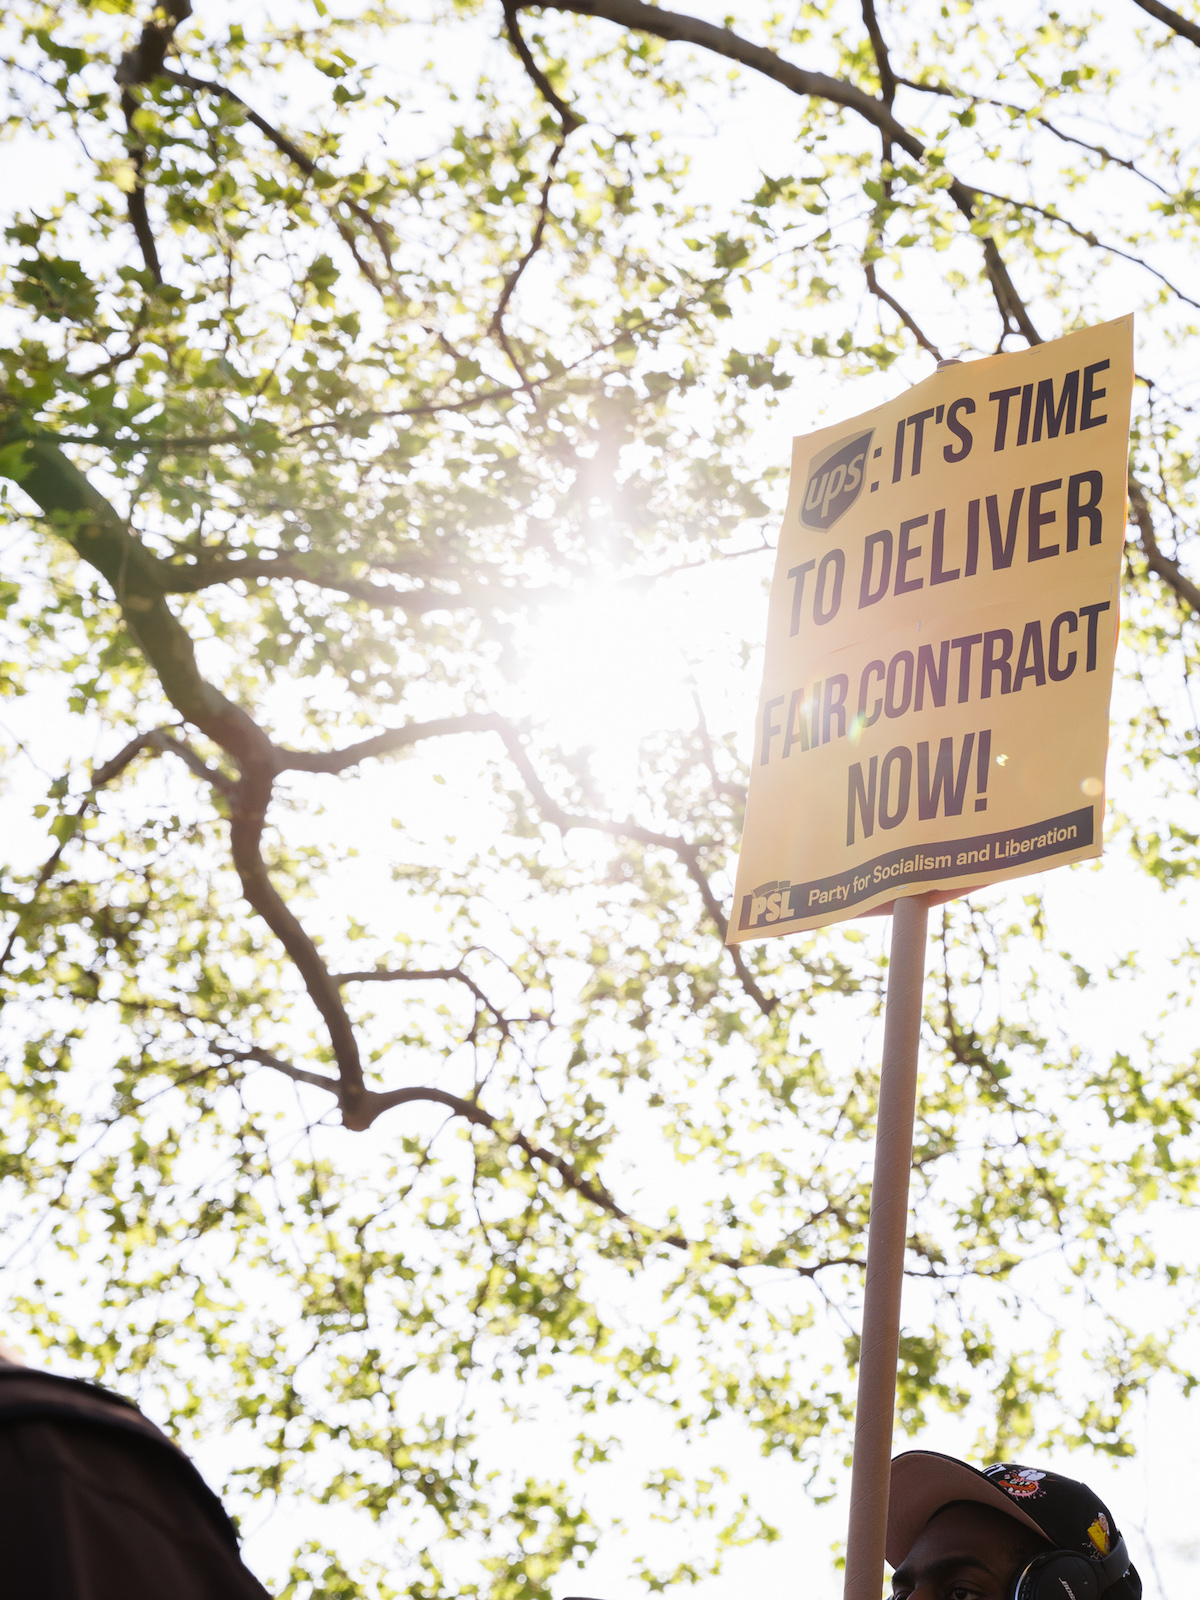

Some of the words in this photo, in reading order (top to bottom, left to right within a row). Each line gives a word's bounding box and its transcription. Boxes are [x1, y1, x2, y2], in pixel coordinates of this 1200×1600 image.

[892, 397, 976, 484] IT'S
[989, 358, 1110, 452] TIME
[787, 548, 846, 638] TO
[858, 470, 1103, 609] DELIVER
[760, 673, 849, 766] FAIR
[857, 601, 1110, 728] CONTRACT
[846, 729, 992, 847] NOW!
[749, 890, 795, 926] PSL
[808, 883, 850, 907] Party
[852, 873, 872, 894] for
[873, 852, 952, 884] Socialism
[956, 845, 990, 867] and
[995, 824, 1077, 860] Liberation
